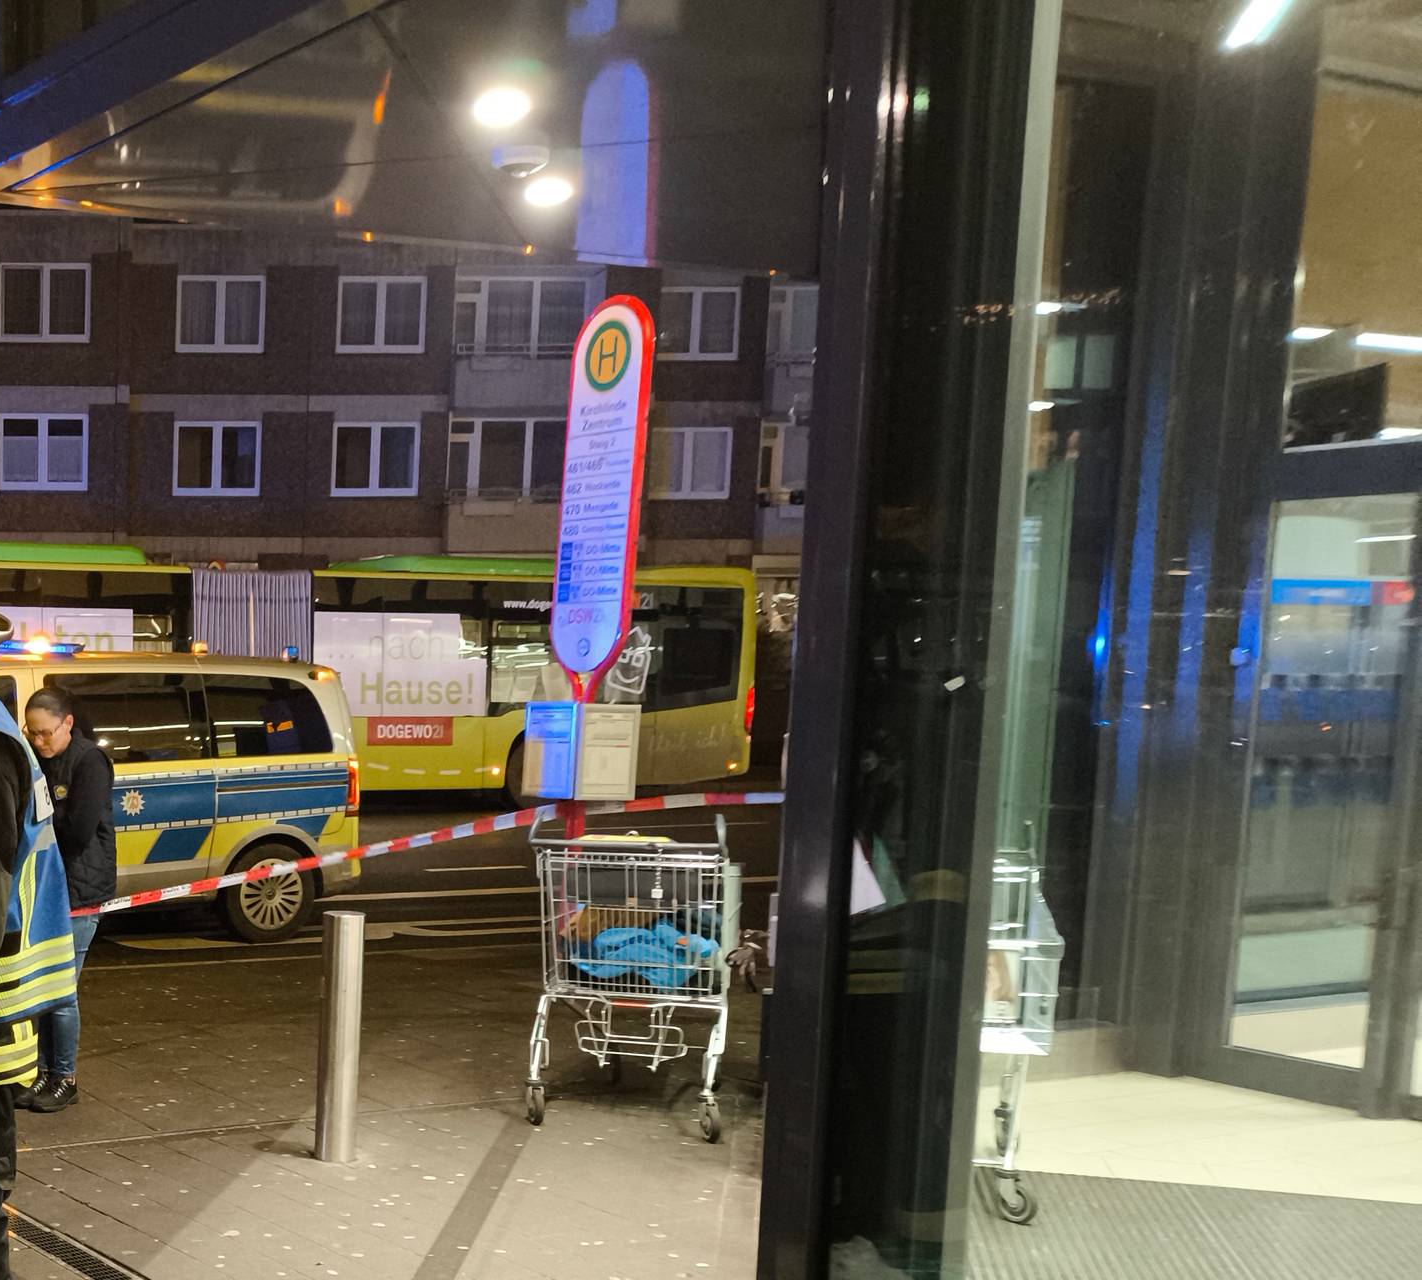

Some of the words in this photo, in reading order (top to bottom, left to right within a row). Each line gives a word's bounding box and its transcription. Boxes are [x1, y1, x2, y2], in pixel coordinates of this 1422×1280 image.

[596, 336, 618, 377] H
[503, 598, 554, 613] www.doge
[360, 672, 474, 705] Hause!
